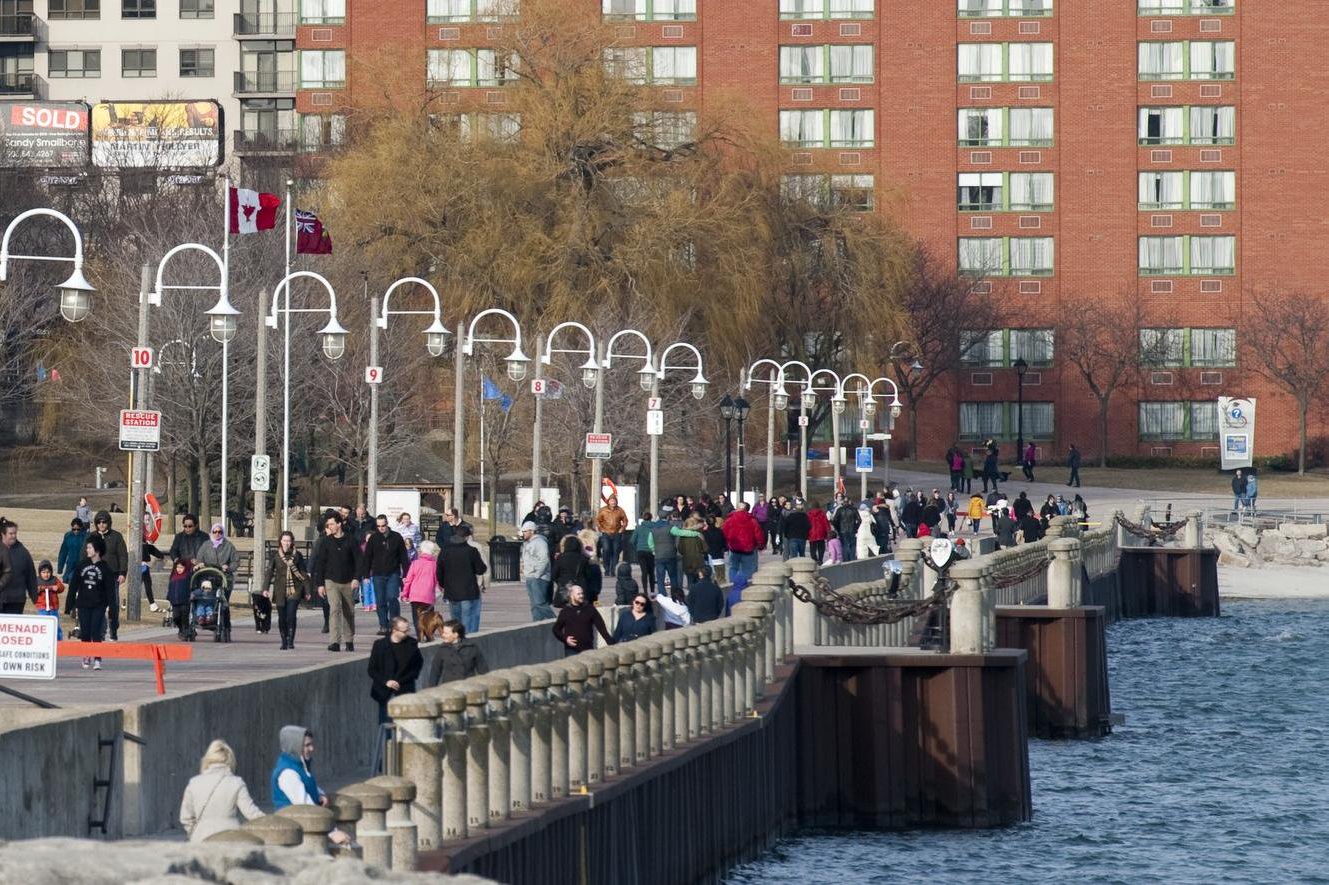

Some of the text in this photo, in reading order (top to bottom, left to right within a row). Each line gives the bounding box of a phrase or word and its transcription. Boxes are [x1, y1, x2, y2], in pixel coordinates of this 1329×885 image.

[22, 106, 80, 129] SOLD
[6, 138, 34, 148] Sandy
[134, 350, 150, 365] 10
[370, 369, 377, 380] 9
[535, 382, 541, 391] 8
[14, 651, 50, 659] CONDITIONS
[3, 662, 22, 671] OWN
[25, 663, 45, 672] RISK
